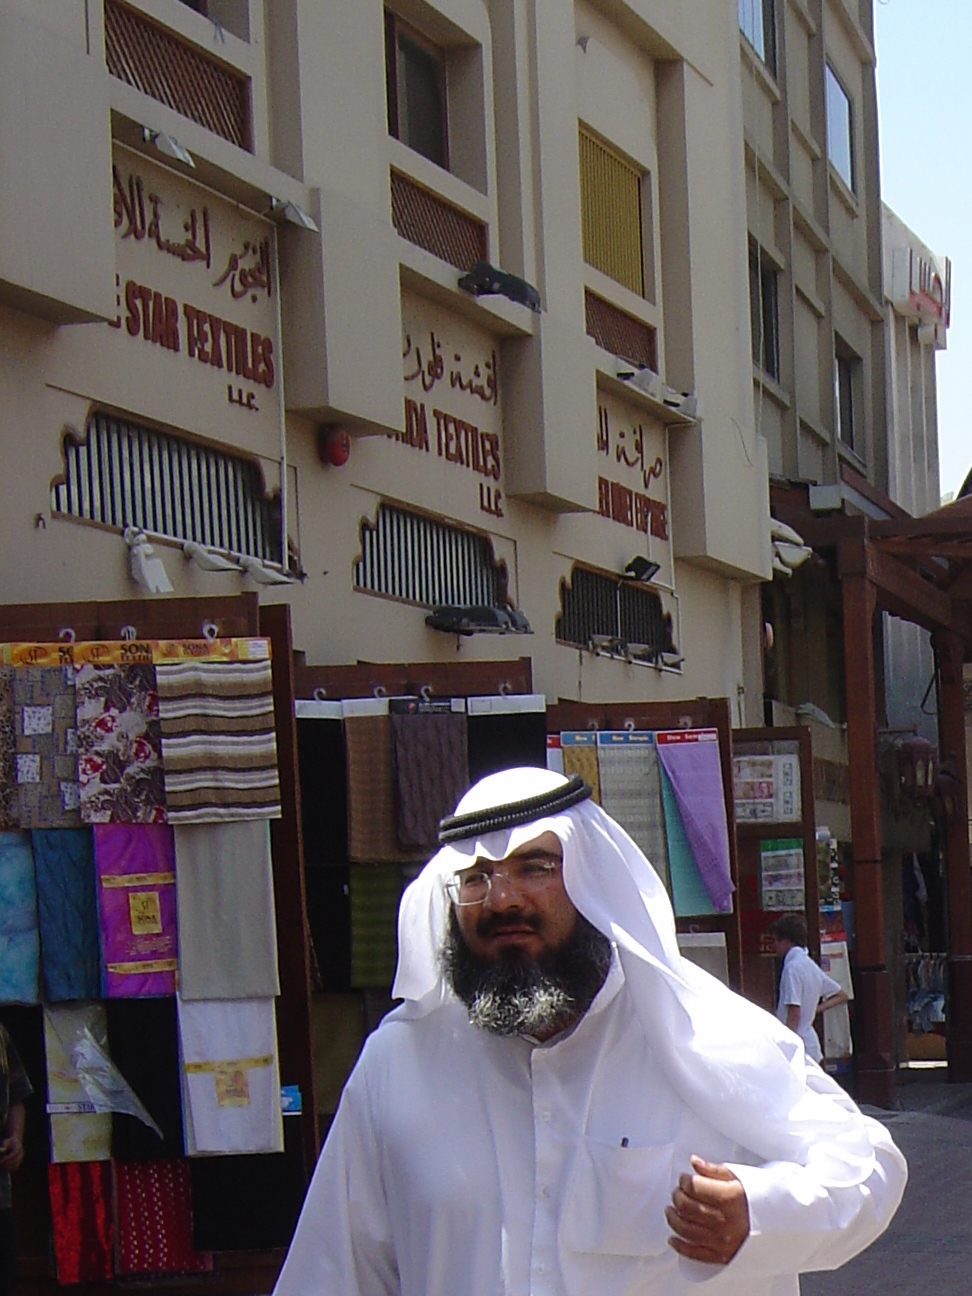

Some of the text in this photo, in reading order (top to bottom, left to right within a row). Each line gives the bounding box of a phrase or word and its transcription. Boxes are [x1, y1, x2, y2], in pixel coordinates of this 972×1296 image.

[126, 280, 180, 352] STAR
[183, 303, 275, 389] TEXTILES
[433, 408, 500, 481] TEXTILES
[120, 643, 151, 655] SON
